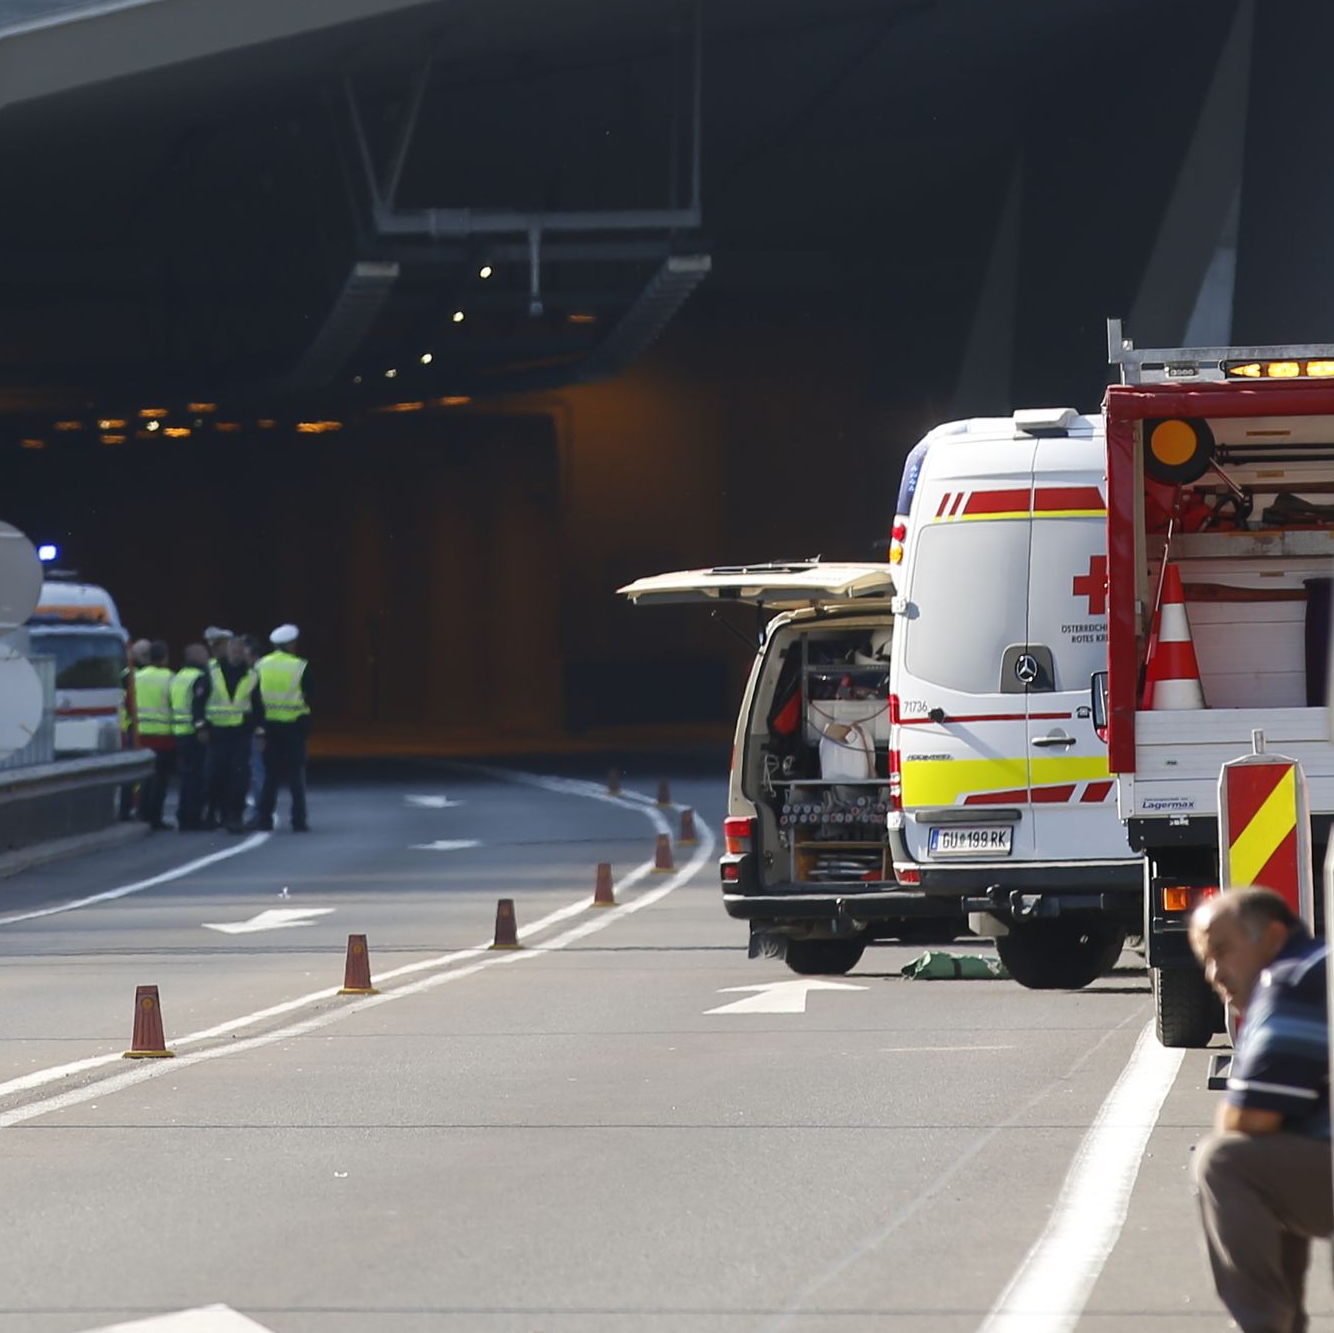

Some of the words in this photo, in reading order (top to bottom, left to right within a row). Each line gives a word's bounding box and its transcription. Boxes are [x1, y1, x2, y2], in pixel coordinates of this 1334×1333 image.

[1071, 635, 1094, 643] ROTES
[904, 700, 928, 713] 71736
[1142, 801, 1195, 810] Lagermax
[943, 832, 958, 849] GU
[991, 830, 1006, 847] RK
